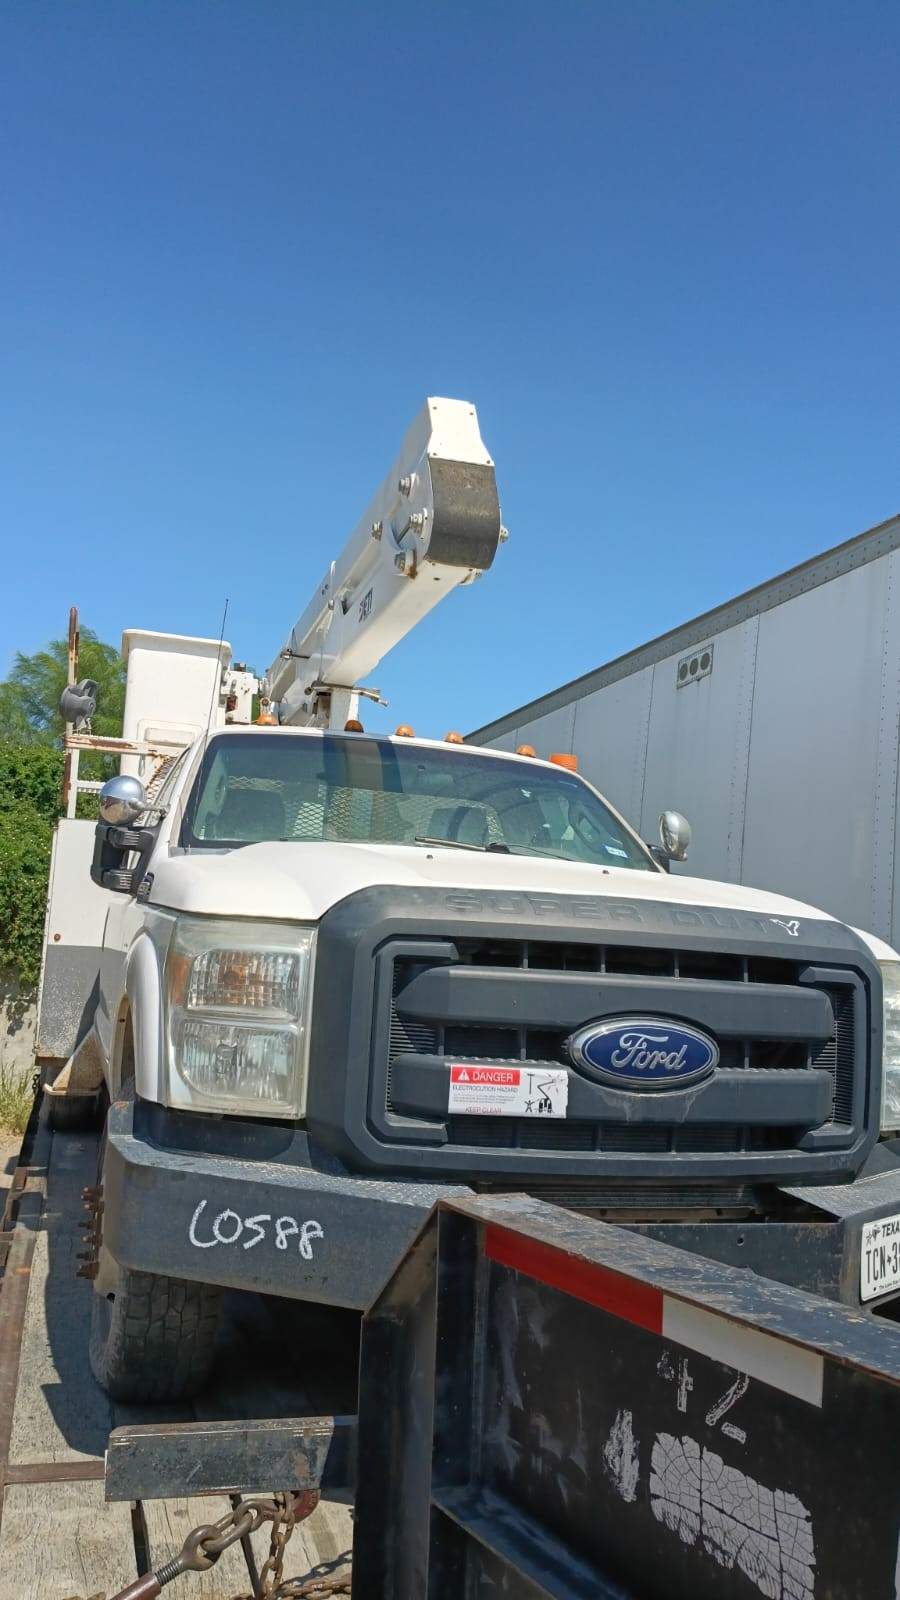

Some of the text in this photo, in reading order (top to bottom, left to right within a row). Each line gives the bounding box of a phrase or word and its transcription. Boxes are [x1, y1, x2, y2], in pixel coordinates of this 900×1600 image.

[446, 892, 645, 923] SUPER
[611, 1032, 688, 1070] Ford
[473, 1071, 513, 1083] DANGER
[882, 1221, 900, 1238] TEXA
